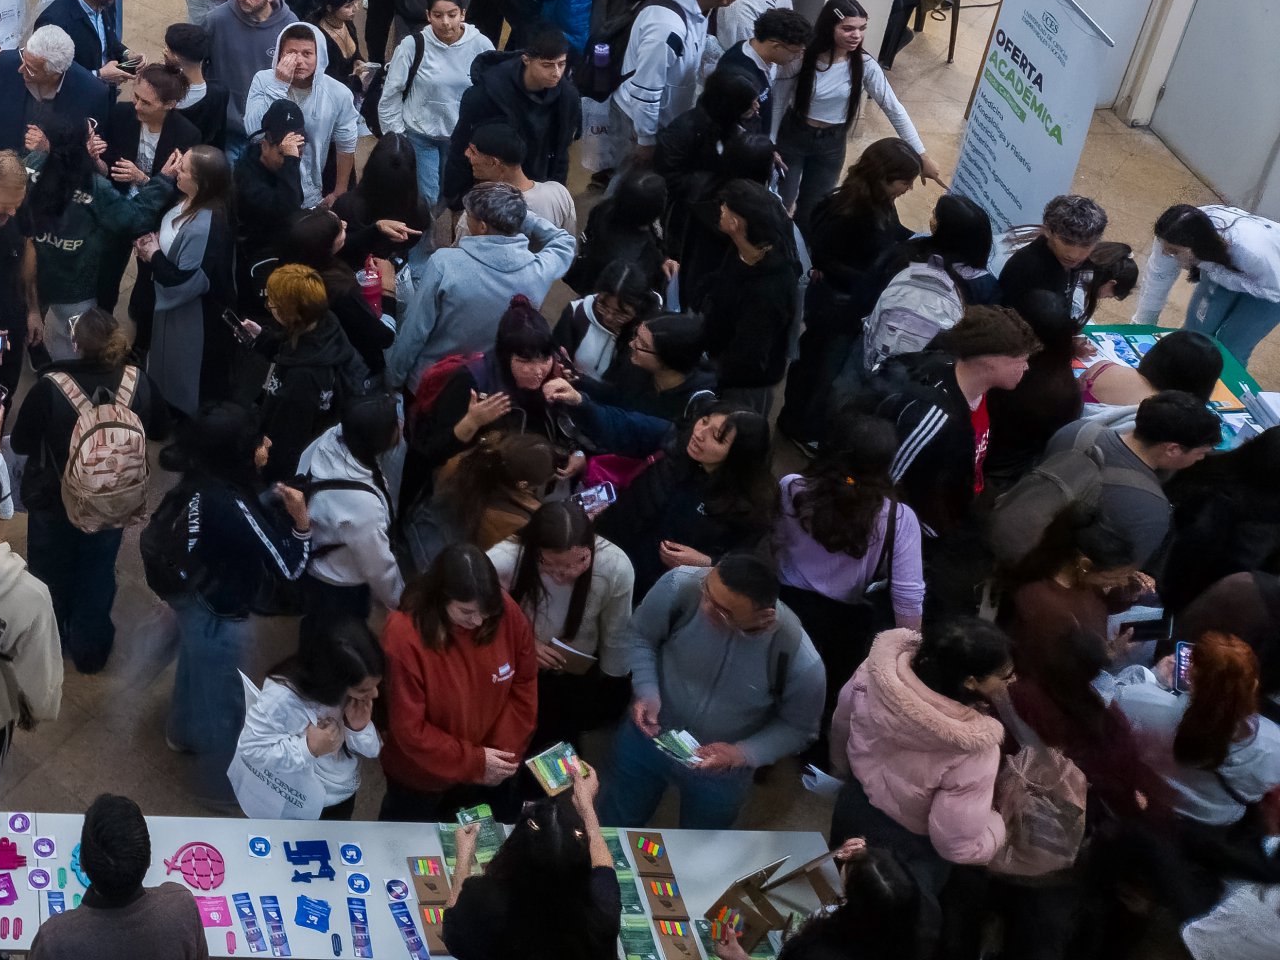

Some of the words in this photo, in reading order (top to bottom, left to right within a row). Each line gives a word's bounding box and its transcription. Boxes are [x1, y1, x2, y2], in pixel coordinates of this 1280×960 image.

[1042, 11, 1059, 35] UCES
[996, 28, 1043, 93] OFERTA
[980, 93, 1004, 121] Medicina
[989, 49, 1063, 146] ACADÉMICA
[1005, 139, 1010, 148] y
[1010, 144, 1032, 173] Fisiatría
[263, 768, 274, 778] DE
[274, 777, 307, 801] CIENCIAS
[270, 782, 304, 809] SOCIALES
